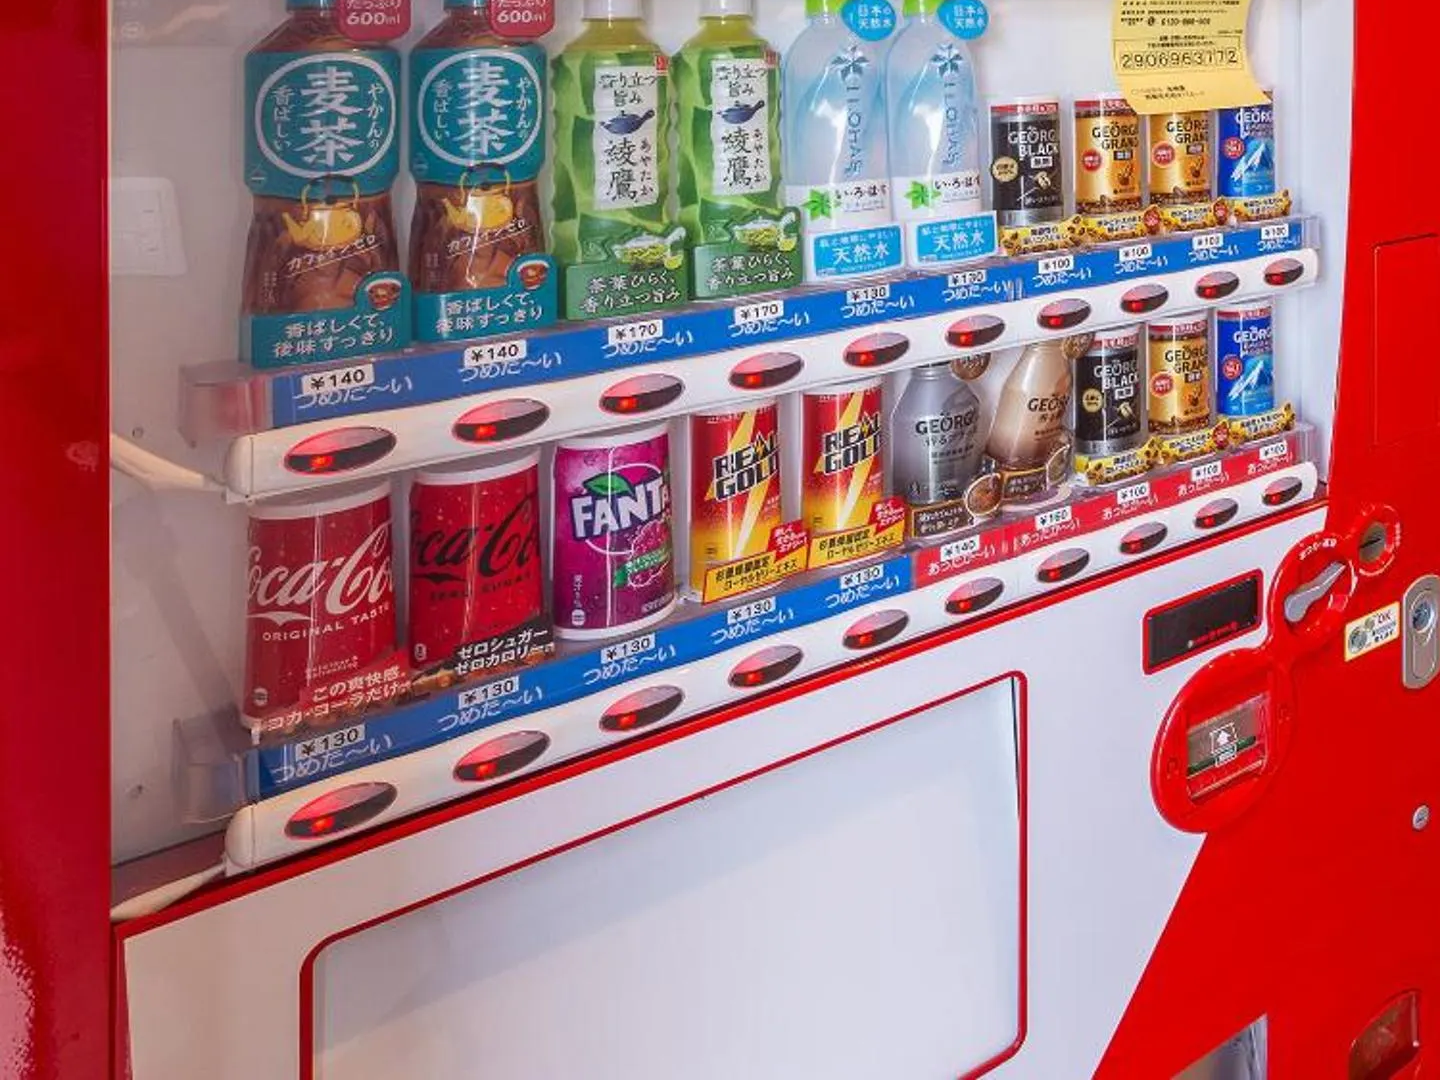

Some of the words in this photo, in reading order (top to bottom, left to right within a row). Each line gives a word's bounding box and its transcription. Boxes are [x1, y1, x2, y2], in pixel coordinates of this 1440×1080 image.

[346, 12, 401, 25] 600ml
[294, 66, 364, 168] 麦茶
[454, 62, 515, 156] 麦茶
[721, 127, 752, 190] 綾鷹
[604, 138, 638, 203] 綾鷹
[932, 231, 986, 252] 天然水
[831, 243, 890, 265] 天然水
[740, 305, 779, 319] ¥170
[614, 323, 658, 339] ¥170
[471, 345, 519, 363] ¥140
[310, 371, 365, 390] ¥140
[732, 600, 772, 621] ¥130
[262, 622, 344, 642] ORIGINAL
[458, 628, 548, 659] ゼロシュガー
[606, 638, 651, 661] ¥130
[464, 679, 515, 704] ¥130
[302, 728, 360, 755] ¥130
